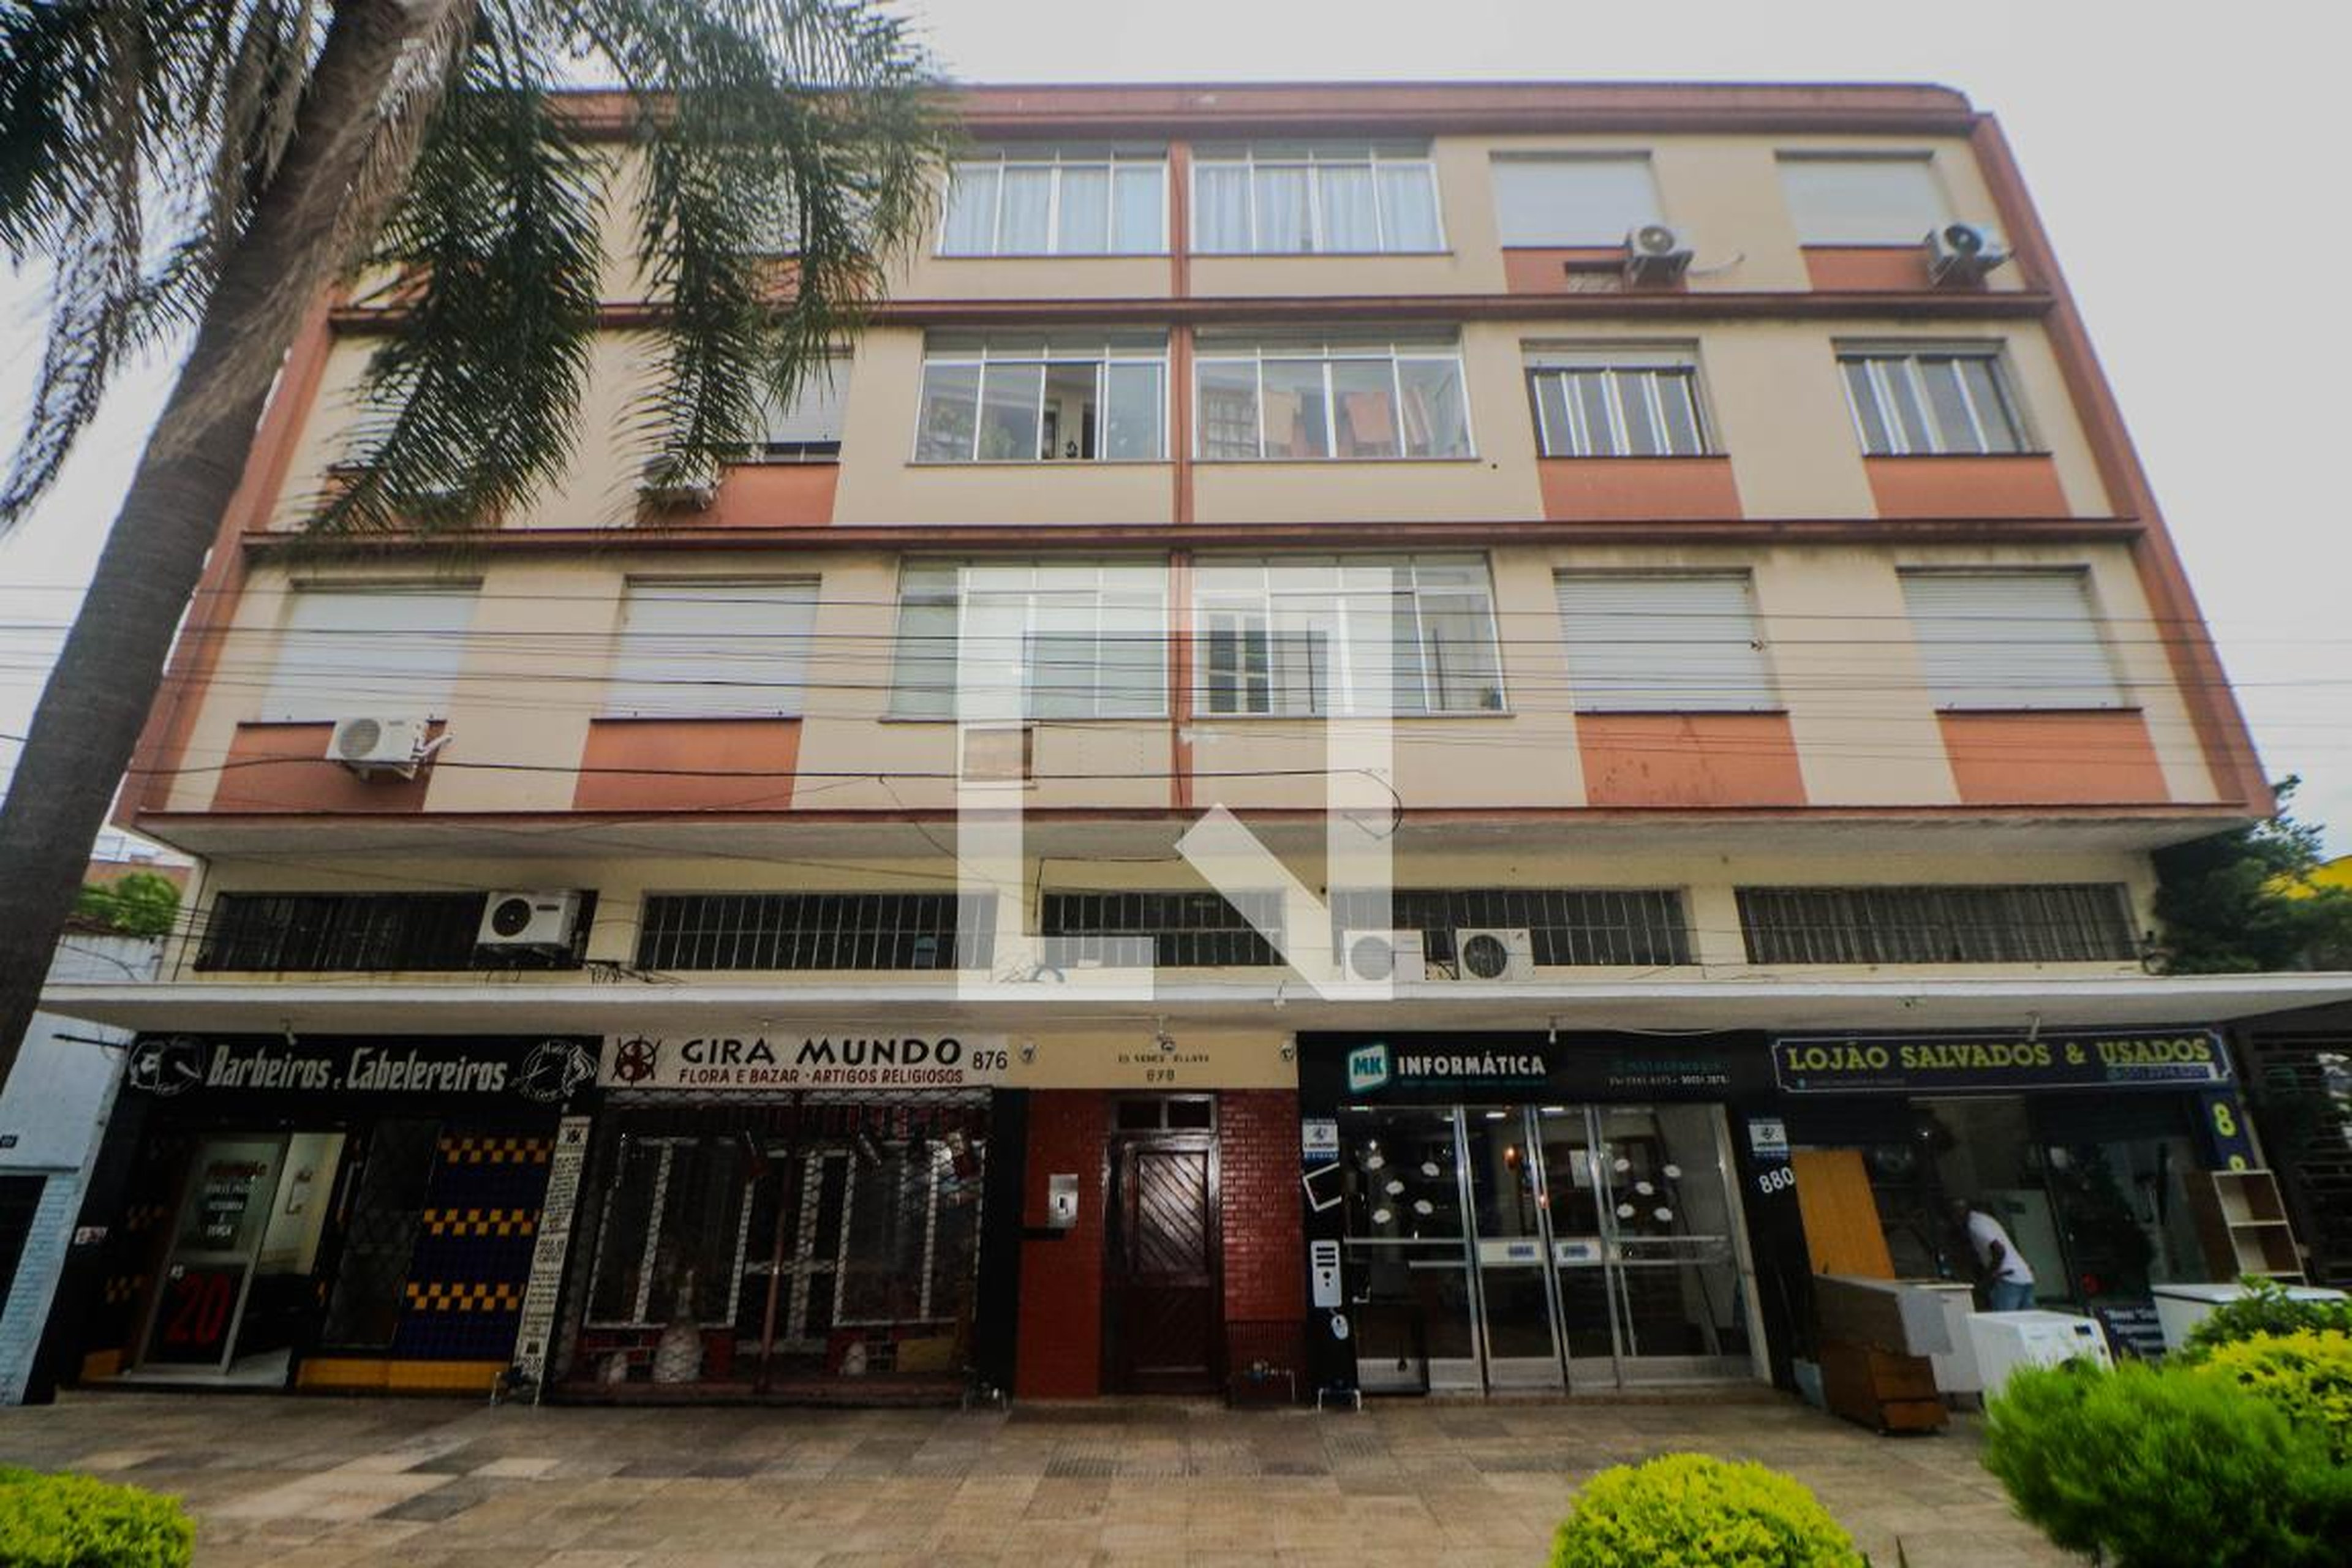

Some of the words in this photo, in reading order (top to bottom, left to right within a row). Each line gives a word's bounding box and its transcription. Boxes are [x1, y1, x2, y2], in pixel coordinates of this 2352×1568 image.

[681, 1038, 776, 1065] GIRA
[796, 1038, 961, 1065] MUNDO
[973, 1050, 1008, 1070] 876
[1354, 1057, 1383, 1075] MK
[1398, 1049, 1547, 1076] INFORMÁTICA
[1787, 1041, 1890, 1071] LOJÃO
[1900, 1044, 2052, 1069] SALVADOS
[2065, 1042, 2089, 1065] &
[2095, 1038, 2211, 1063] USADOS
[205, 1043, 333, 1090] Barbeiros
[346, 1046, 508, 1092] Cabelereiros
[679, 1069, 729, 1084] FLORA
[736, 1069, 745, 1083] E
[748, 1069, 799, 1083] BAZAR
[812, 1069, 877, 1083] ARTIGOS
[881, 1068, 963, 1084] RELIGIOSOS
[1758, 1166, 1795, 1194] 880
